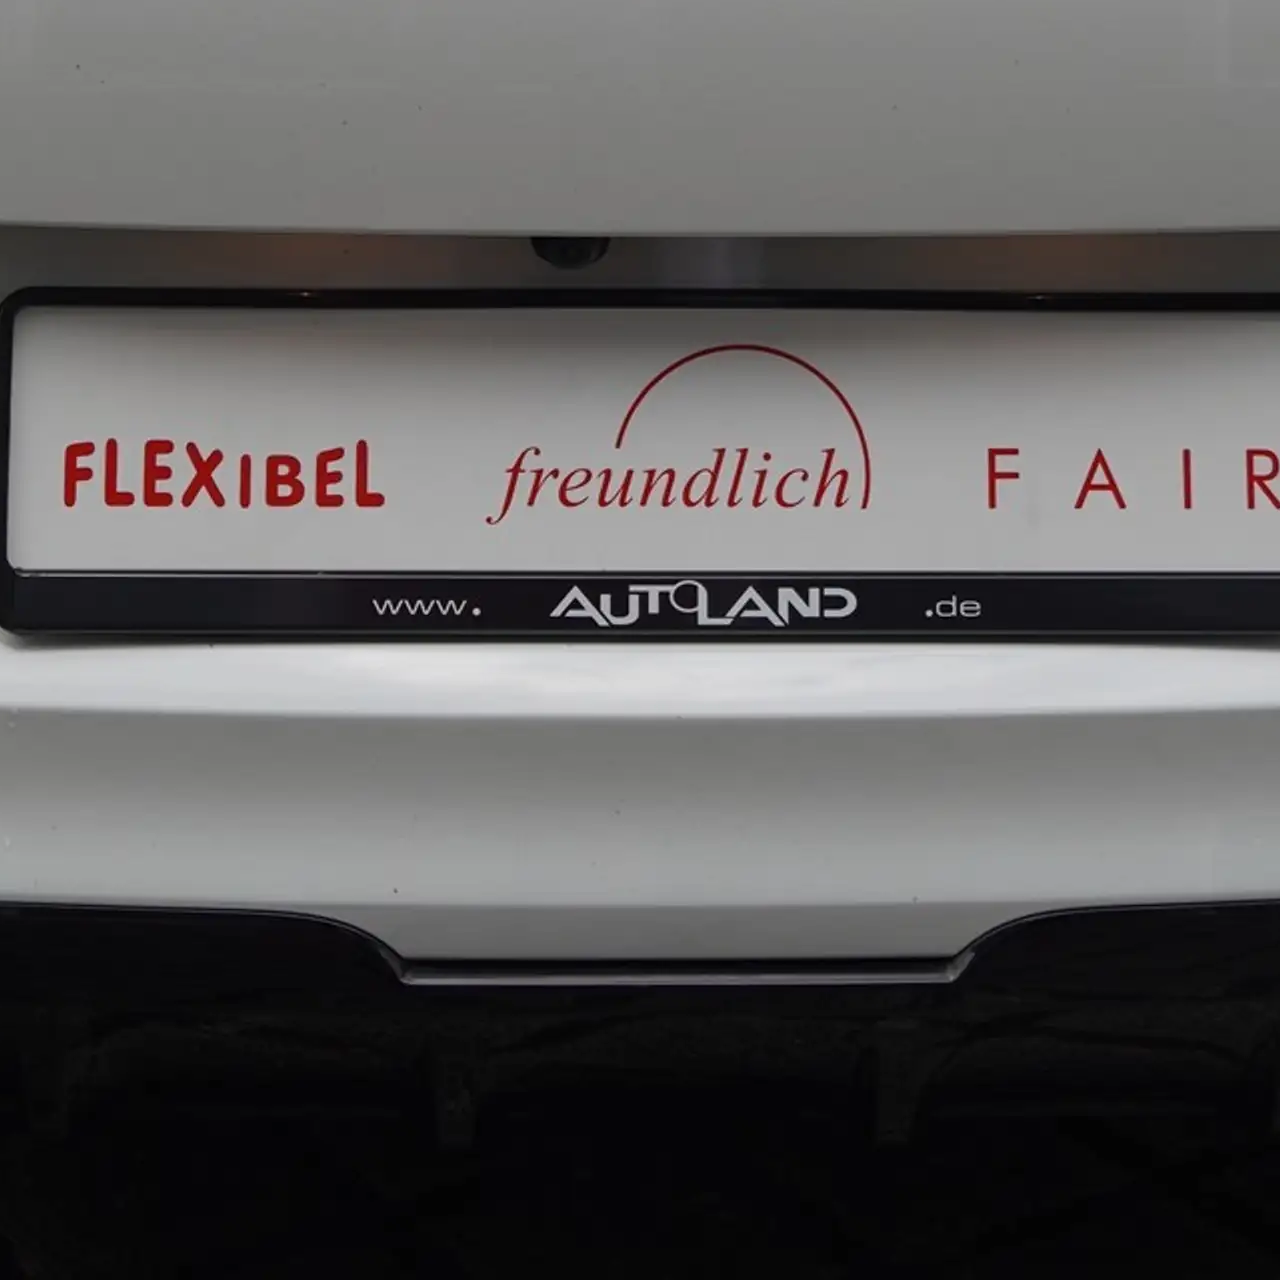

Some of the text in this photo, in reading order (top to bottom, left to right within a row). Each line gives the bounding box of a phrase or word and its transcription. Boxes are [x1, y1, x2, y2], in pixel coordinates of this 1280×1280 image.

[63, 439, 386, 510] FLEXIBEL
[485, 446, 851, 525] freundlich
[372, 578, 983, 628] www. AUTOLAND .de
